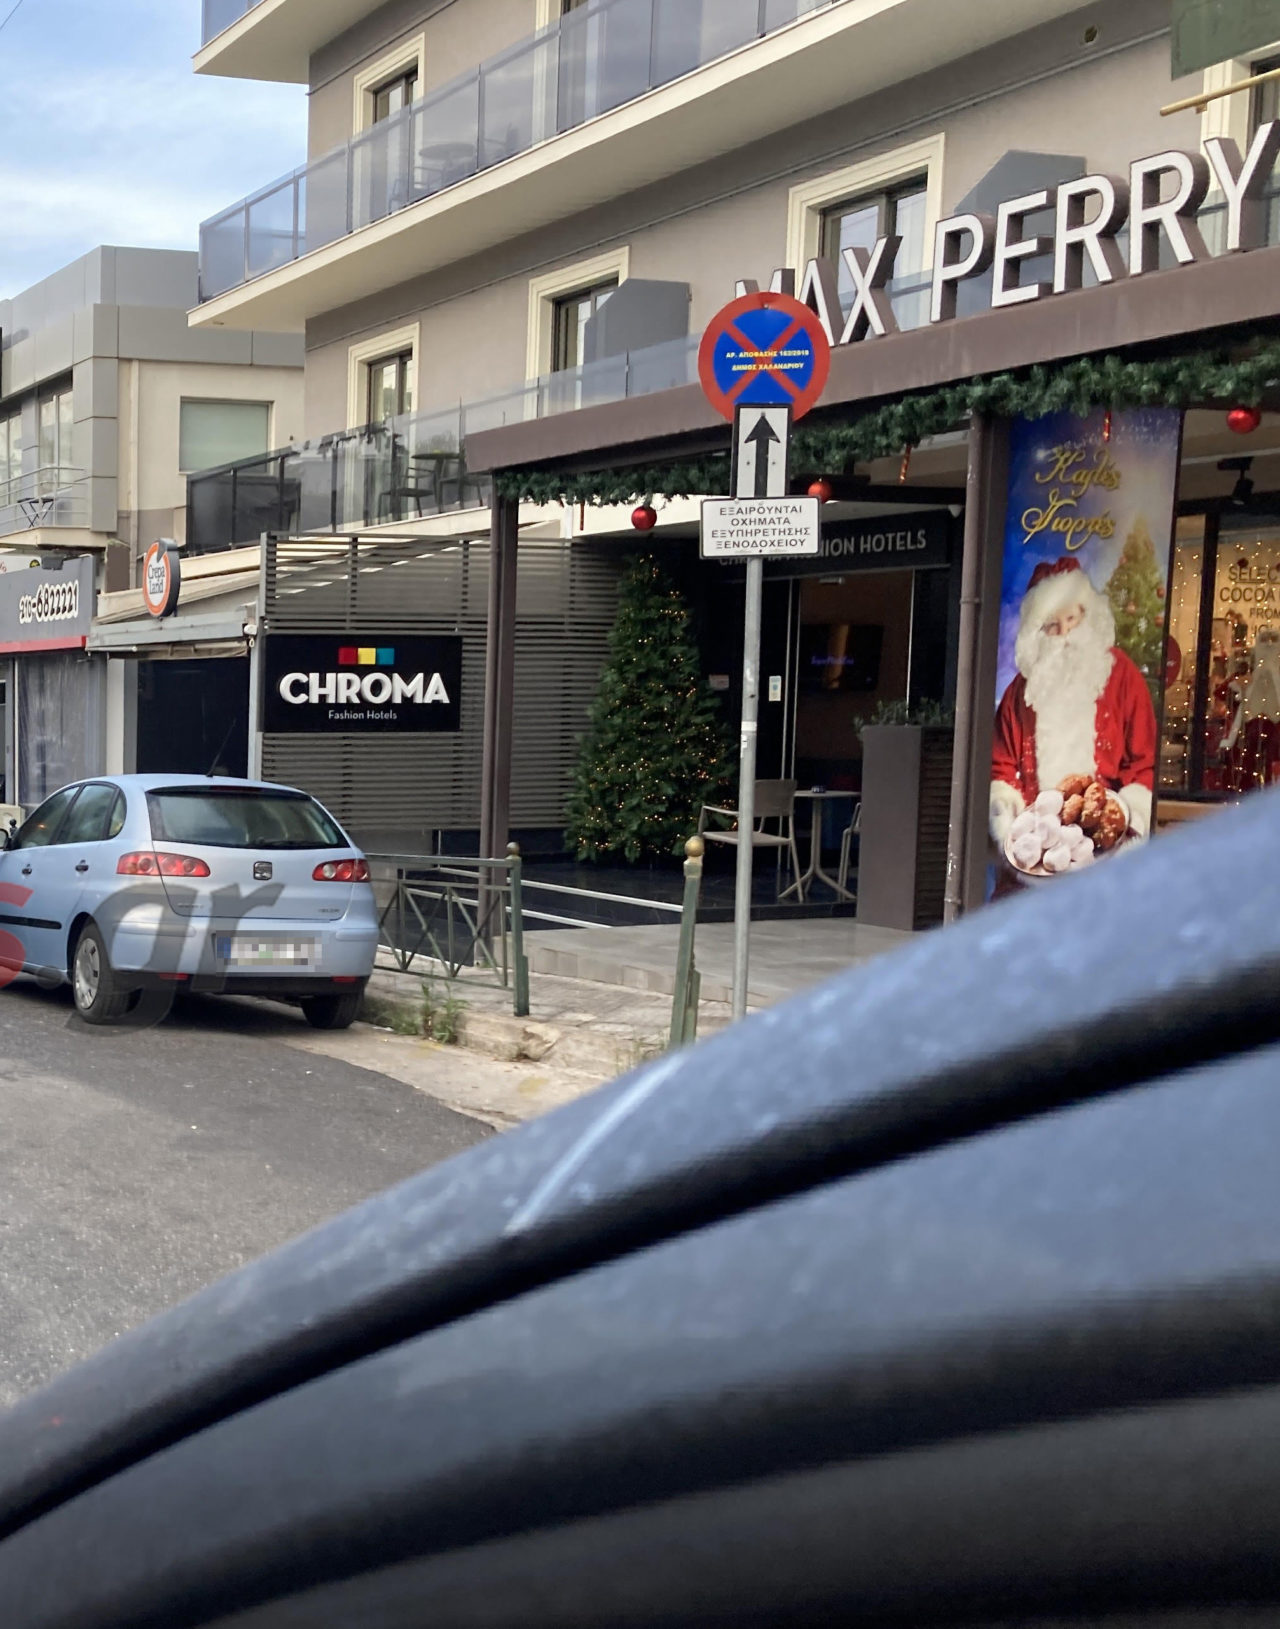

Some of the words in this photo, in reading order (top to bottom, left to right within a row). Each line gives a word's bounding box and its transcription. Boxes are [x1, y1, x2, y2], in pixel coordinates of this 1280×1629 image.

[929, 119, 1280, 323] PERRY
[719, 505, 803, 516] ΕΞΑΙΡΟΥΝΤΑΙ
[730, 516, 791, 526] ΟΧΗΜΑΤΑ
[711, 527, 811, 538] ΕΞΥΠΗΡΕΤΗΣΗΣ
[715, 538, 807, 549] ΞΕΝΟΔΟΧΕΙΟΥ
[859, 529, 927, 553] HOTELS
[148, 564, 166, 581] Crepa
[19, 581, 79, 623] 210-6822221
[1220, 586, 1276, 602] COCOA
[279, 672, 450, 705] CHROMA
[328, 709, 365, 720] Fashion
[366, 709, 398, 720] Hotels
